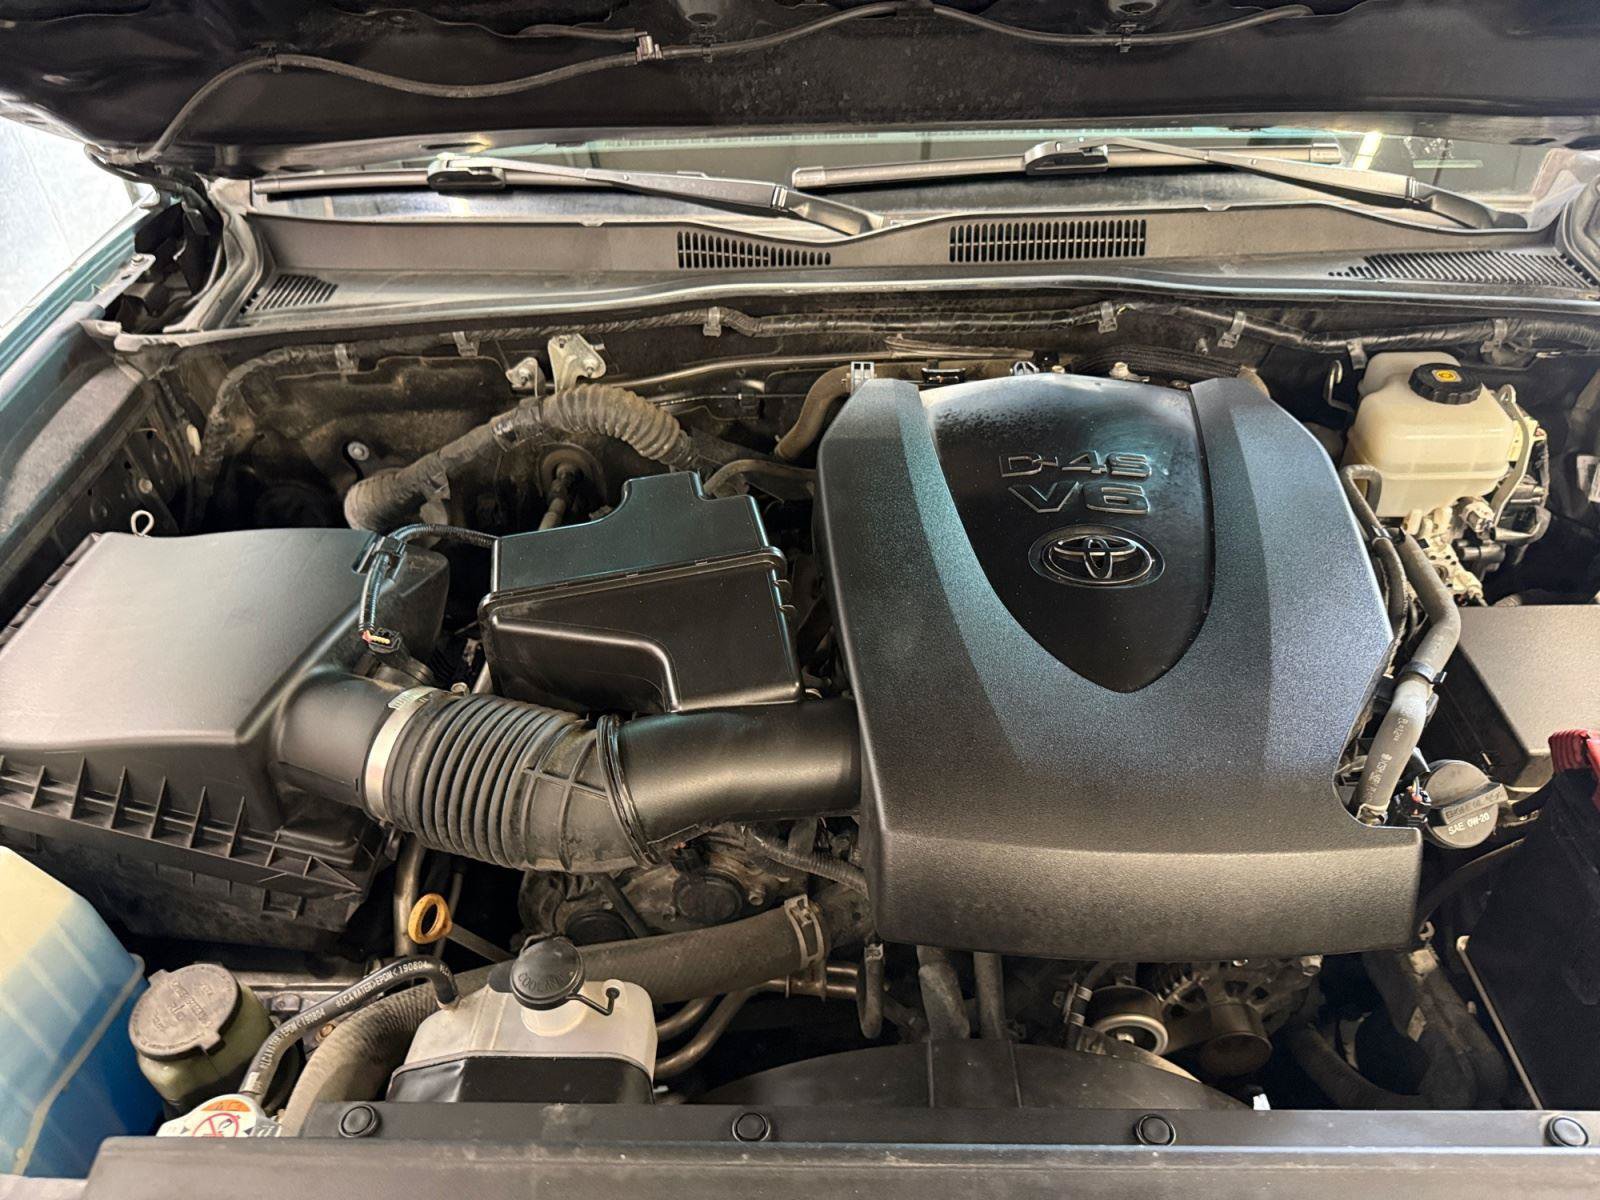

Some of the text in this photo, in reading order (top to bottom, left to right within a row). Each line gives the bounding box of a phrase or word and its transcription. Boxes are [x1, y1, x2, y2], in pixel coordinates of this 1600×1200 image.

[999, 450, 1152, 478] D-4S
[1008, 480, 1151, 514] V6
[1448, 822, 1466, 836] SAE
